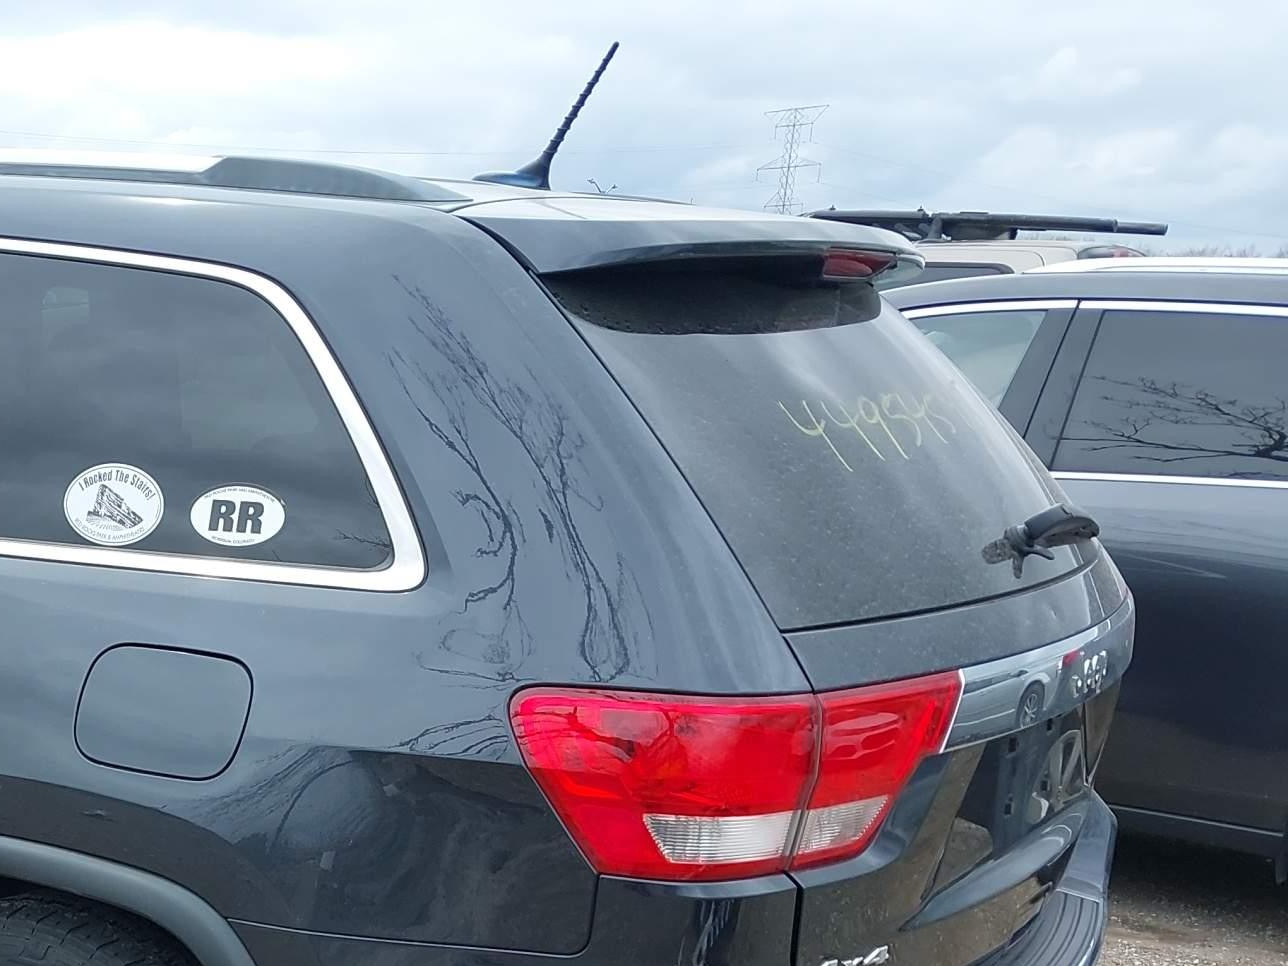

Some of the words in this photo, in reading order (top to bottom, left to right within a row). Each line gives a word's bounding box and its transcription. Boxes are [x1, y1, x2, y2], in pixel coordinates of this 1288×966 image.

[83, 470, 113, 488] Rocked
[115, 469, 130, 484] The
[130, 474, 156, 501] Stairs!
[208, 499, 265, 534] RR
